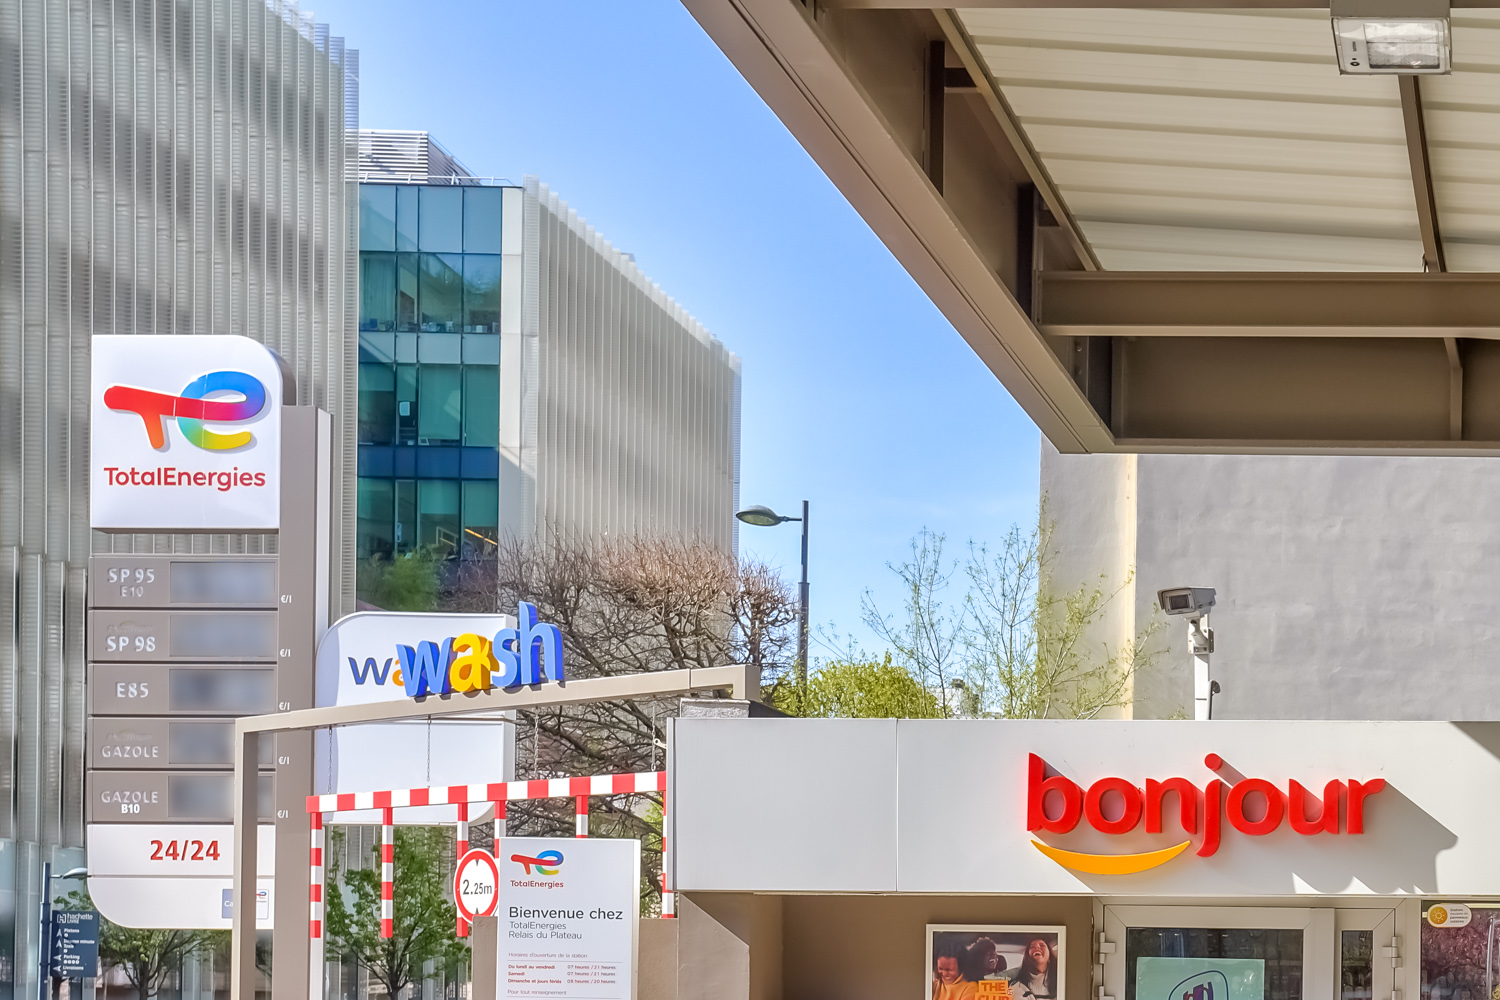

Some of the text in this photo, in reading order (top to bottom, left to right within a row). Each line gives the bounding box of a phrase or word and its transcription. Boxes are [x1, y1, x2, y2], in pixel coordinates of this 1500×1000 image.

[103, 467, 266, 491] TotalEnergies
[108, 569, 154, 583] SP 95
[121, 587, 144, 597] E10
[106, 636, 156, 651] SP 98
[396, 600, 564, 697] wash
[116, 683, 148, 698] E85
[102, 746, 159, 758] GAZOLE
[101, 791, 158, 803] GAZOLE
[121, 804, 140, 813] B10
[1026, 752, 1386, 857] bonjour
[150, 840, 220, 861] 24/24
[463, 879, 492, 895] 2.25m
[510, 880, 564, 889] TotalEnergies
[509, 906, 623, 919] Bienvenue chez
[510, 921, 566, 930] TotalEnergies
[981, 982, 1005, 992] THE
